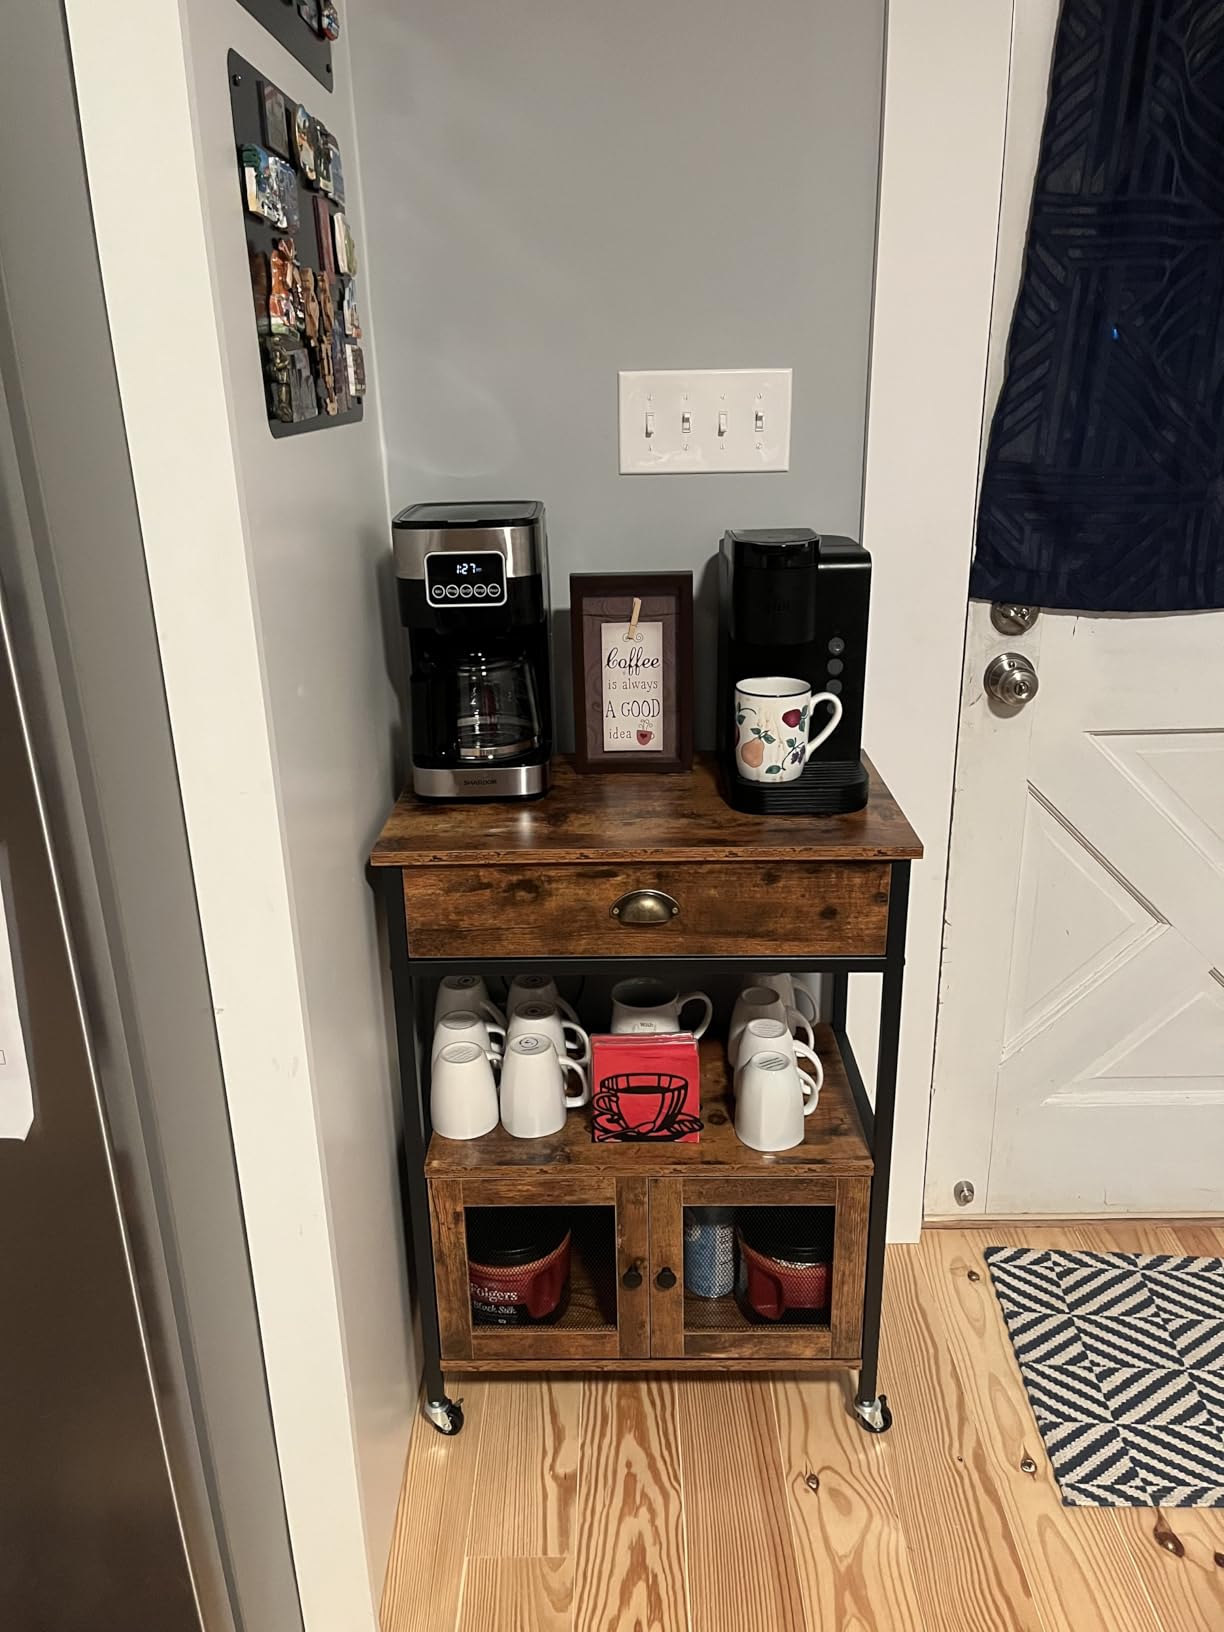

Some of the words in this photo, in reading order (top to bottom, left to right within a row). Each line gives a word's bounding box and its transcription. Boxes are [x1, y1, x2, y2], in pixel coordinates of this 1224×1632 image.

[456, 563, 476, 575] 1:27
[605, 646, 661, 676] Coffee
[608, 680, 617, 690] is
[622, 678, 658, 692] always
[605, 701, 616, 718] A
[621, 699, 660, 718] GOOD
[609, 727, 632, 739] idea
